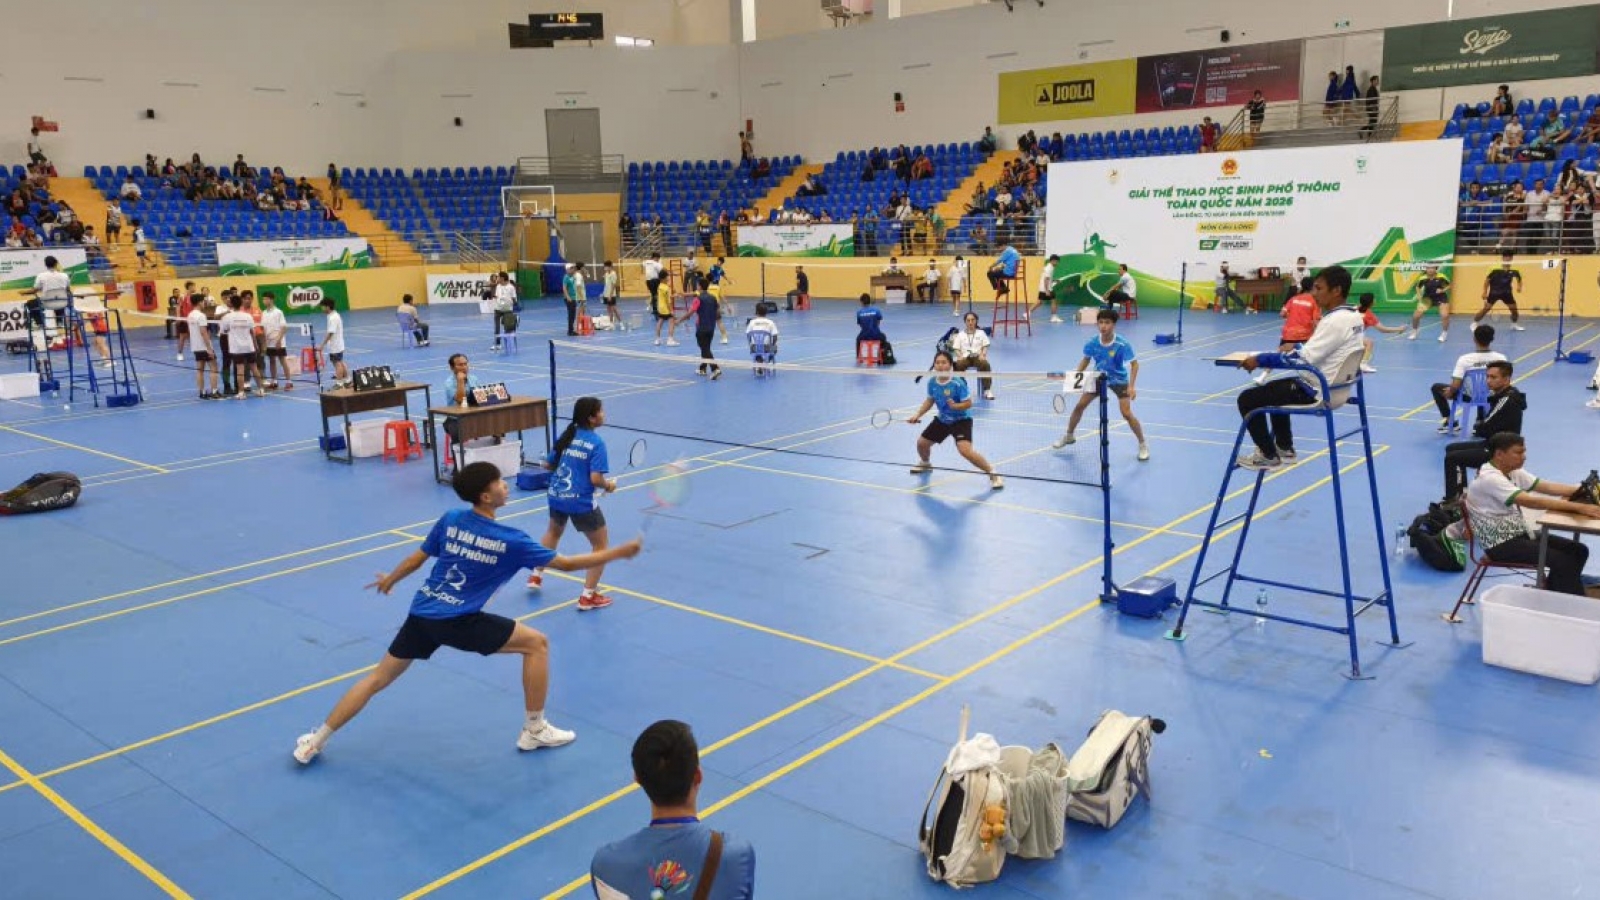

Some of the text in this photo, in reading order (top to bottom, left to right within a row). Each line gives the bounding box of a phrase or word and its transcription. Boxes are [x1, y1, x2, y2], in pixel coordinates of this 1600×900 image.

[1460, 29, 1512, 54] Sera
[1055, 82, 1094, 102] JOOLA
[1176, 187, 1206, 197] THAO
[1209, 186, 1234, 197] HỌC
[1236, 184, 1264, 195] SINH
[1297, 180, 1341, 192] THÔNG
[1166, 198, 1197, 209] TOÀN
[1265, 196, 1294, 207] 2026
[292, 292, 320, 304] MILO
[1073, 372, 1084, 390] 2
[460, 546, 498, 565] PHÒNG
